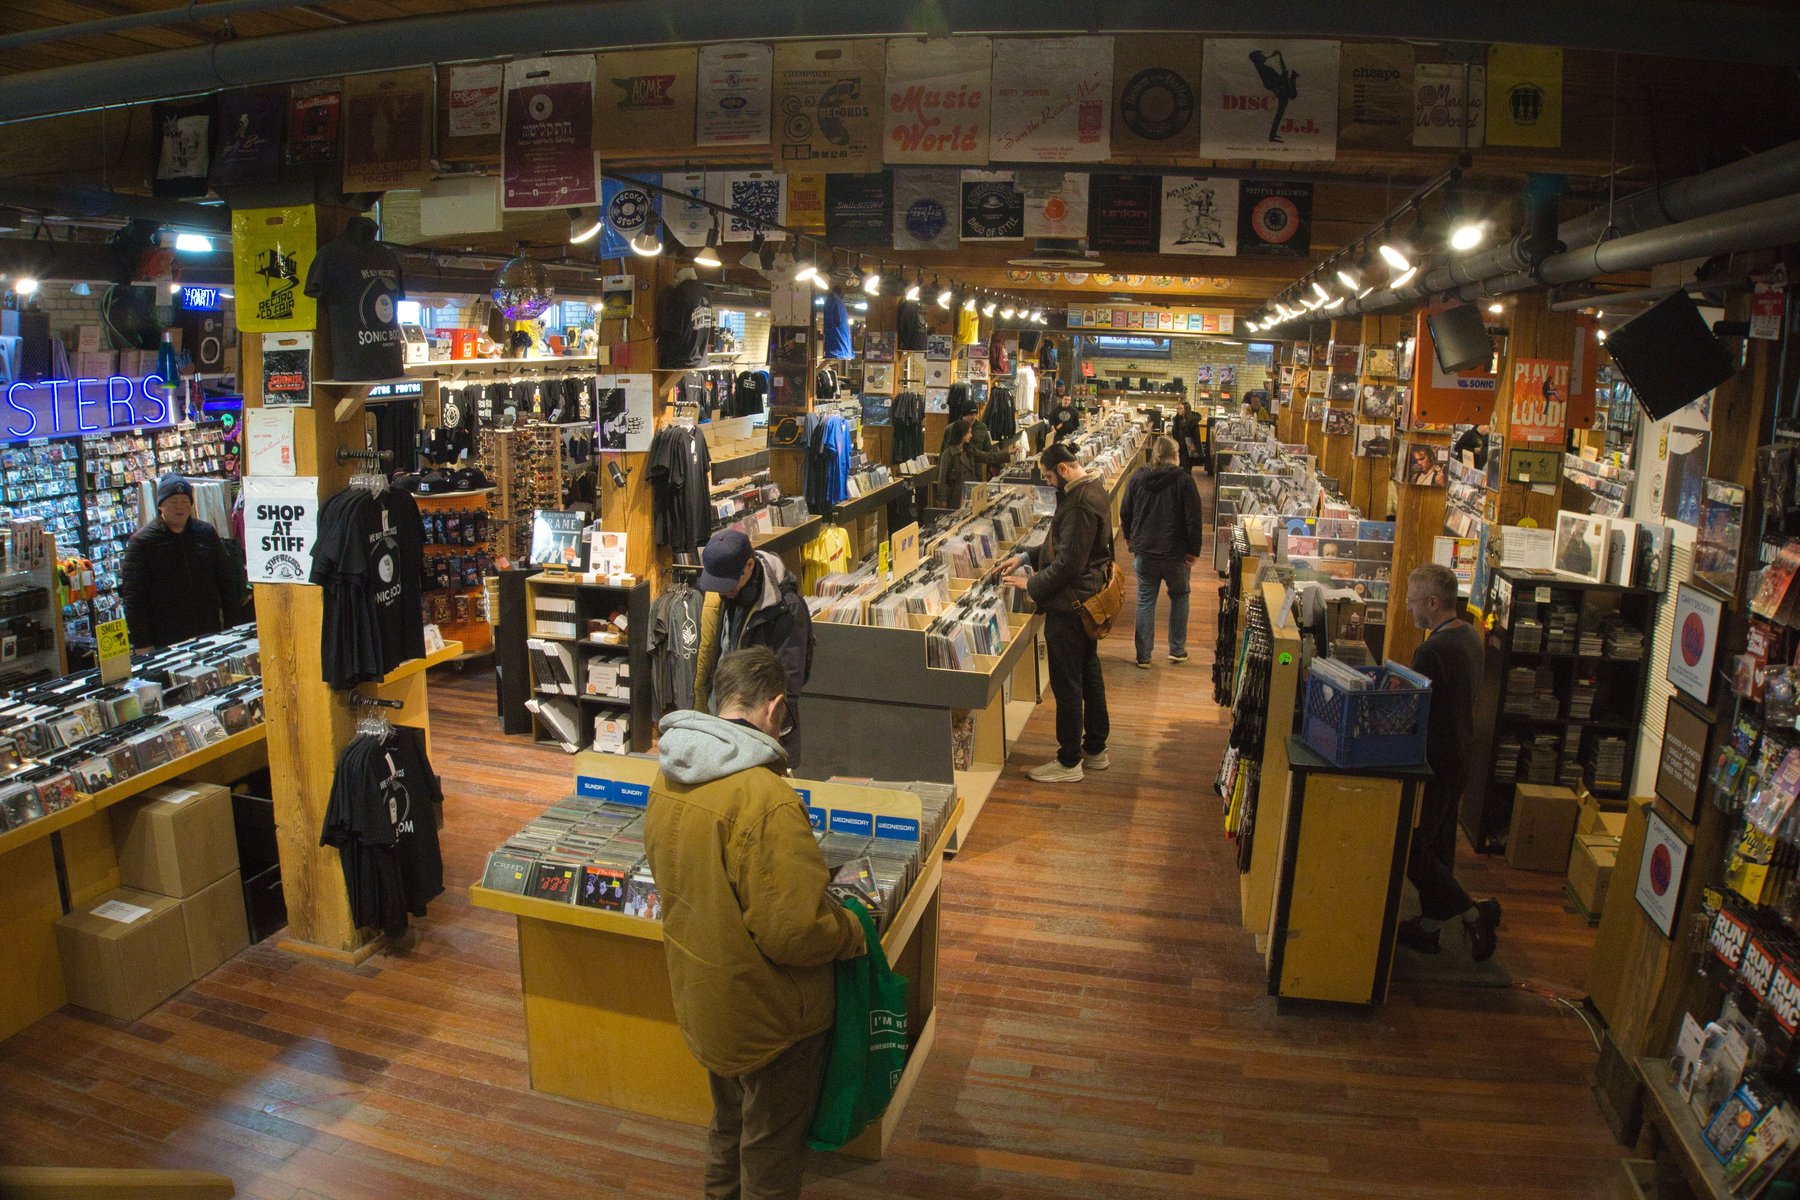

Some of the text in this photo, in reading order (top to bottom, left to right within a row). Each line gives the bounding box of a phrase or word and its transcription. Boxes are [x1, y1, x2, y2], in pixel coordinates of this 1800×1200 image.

[1353, 66, 1400, 80] cheapo
[632, 78, 664, 100] ACME
[889, 84, 982, 120] Music
[1222, 94, 1279, 111] DISC
[820, 105, 870, 119] RECORDS
[1280, 118, 1320, 134] J.J.
[891, 124, 981, 152] World
[616, 191, 644, 205] record
[792, 190, 818, 201] TOWER
[616, 215, 642, 226] store
[1102, 208, 1148, 218] union
[985, 226, 996, 238] OF
[258, 291, 294, 313] RECORD
[358, 330, 388, 347] SONIC
[1514, 362, 1569, 386] PLAY IT
[1469, 379, 1494, 389] SONIC
[6, 373, 168, 438] STERS
[1511, 400, 1566, 428] LOUD!
[257, 504, 305, 522] SHOP
[271, 521, 293, 537] AT
[261, 536, 304, 553] STIFF
[584, 782, 606, 792] SUNDAY
[620, 787, 643, 798] SUNDAY
[832, 815, 870, 827] WEDNESDAY
[877, 822, 916, 832] WEDNESDAY
[493, 860, 524, 872] CREED
[1715, 911, 1747, 948] RUN
[1711, 928, 1741, 963] DMC
[1745, 942, 1774, 981] RUN
[1742, 958, 1768, 997] DMC
[1772, 968, 1800, 1009] RUN
[1768, 985, 1800, 1028] DMC
[874, 1015, 893, 1027] I'M
